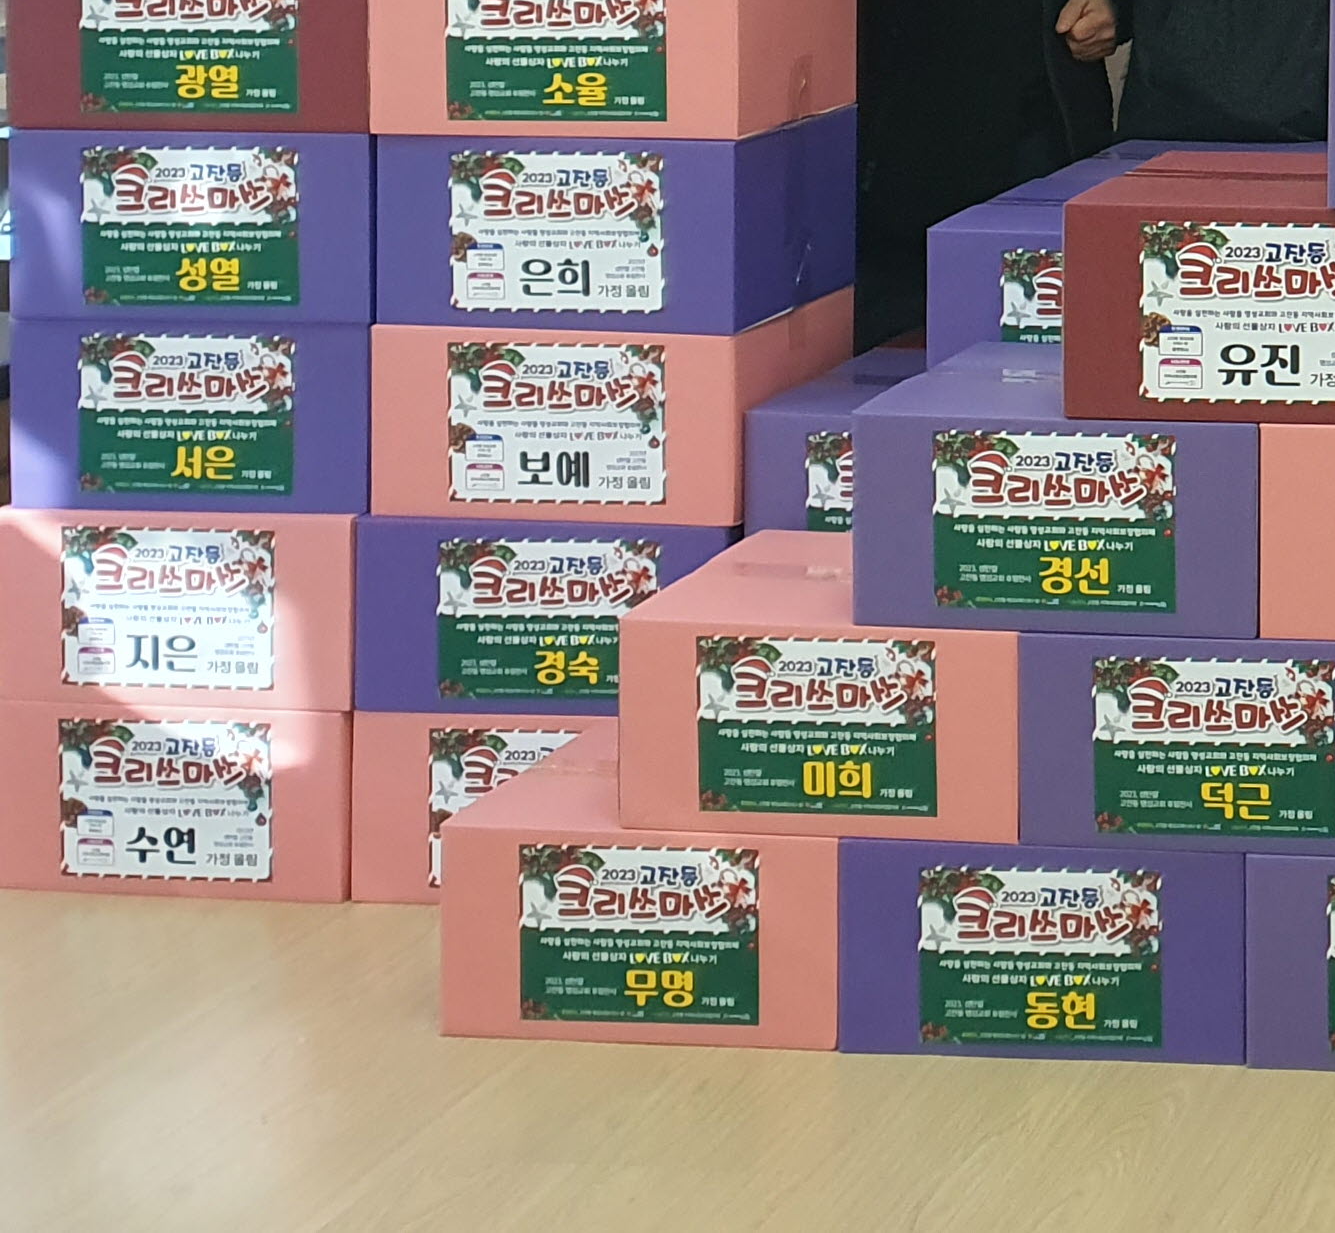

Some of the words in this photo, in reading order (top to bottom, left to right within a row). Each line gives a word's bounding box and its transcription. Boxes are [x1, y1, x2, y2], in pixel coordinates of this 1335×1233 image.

[177, 65, 238, 98] 광열
[544, 73, 607, 106] 소율
[178, 258, 239, 291] 성열
[520, 258, 590, 296] 은희
[1218, 344, 1300, 386] 유진
[174, 446, 233, 479] 서은
[518, 451, 589, 487] 보예
[598, 476, 623, 489] 가정
[626, 476, 651, 489] 올림
[1015, 454, 1051, 466] 2023
[1055, 450, 1115, 472] 고잔동
[1040, 557, 1109, 594] 경선
[127, 635, 195, 672] 지은
[537, 651, 598, 684] 경숙
[504, 750, 535, 761] 2023
[803, 761, 871, 798] 미희
[1201, 782, 1270, 819] 덕근
[126, 826, 195, 864] 수연
[626, 970, 693, 1007] 무명
[1027, 991, 1095, 1029] 동현
